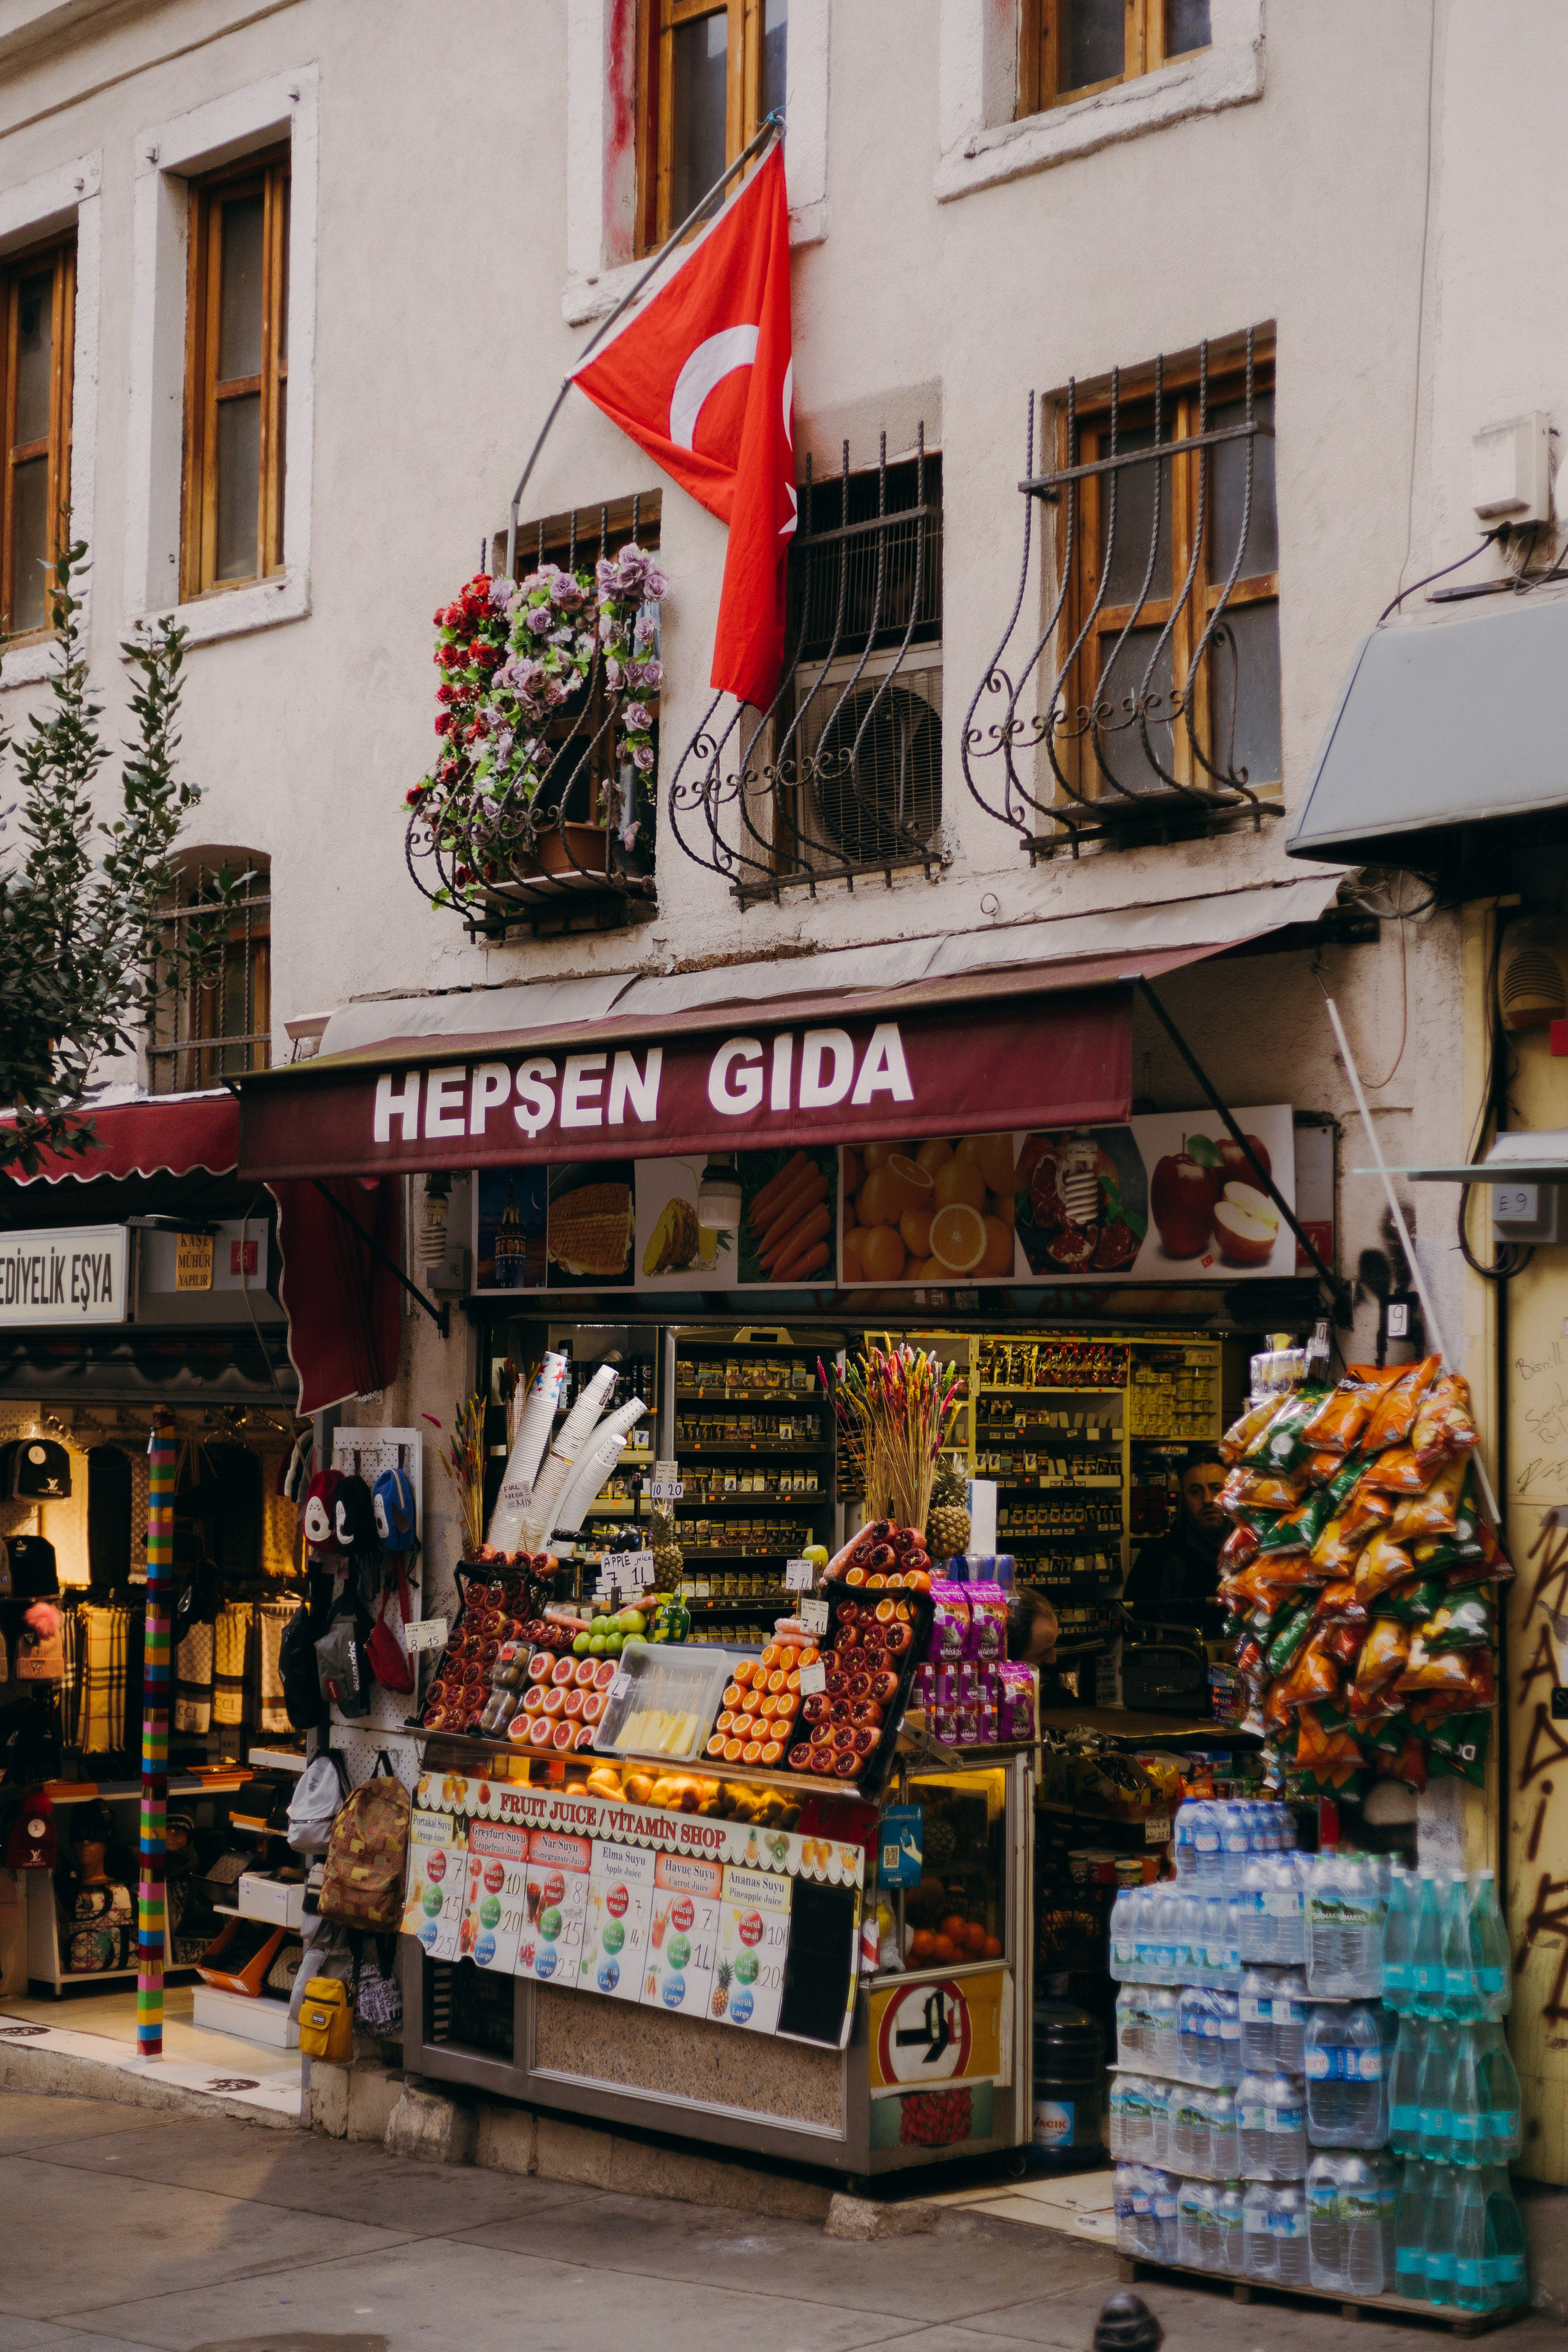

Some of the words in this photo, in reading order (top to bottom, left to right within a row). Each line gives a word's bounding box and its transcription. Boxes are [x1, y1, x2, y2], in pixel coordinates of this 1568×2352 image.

[374, 1047, 663, 1142] HEPŞEN
[707, 1023, 914, 1115] GIDA
[178, 1250, 210, 1268] MÜHÜR
[71, 1254, 112, 1311] EŞYA
[179, 1274, 208, 1286] YAPILIR
[654, 1485, 661, 1496] 10
[668, 1484, 682, 1495] 20
[604, 1555, 630, 1568] APPLE
[606, 1572, 617, 1586] 7
[788, 1578, 794, 1589] 7
[799, 1577, 810, 1589] 14
[802, 1618, 809, 1631] 7
[815, 1621, 825, 1634] 14
[410, 1640, 418, 1651] 8
[427, 1636, 439, 1647] 15
[413, 1814, 436, 1829] Portakal
[437, 1819, 451, 1832] Suyu
[500, 1792, 546, 1818] FRUIT
[549, 1801, 597, 1826] JUICE
[608, 1807, 676, 1841] VİTAMİN
[680, 1823, 726, 1850] SHOP
[472, 1824, 505, 1840] Greyfurt
[506, 1830, 526, 1845] Suyu
[473, 1839, 505, 1855] Grapefruit
[506, 1845, 522, 1856] Juice
[541, 1835, 556, 1849] Nar
[557, 1838, 579, 1853] Suyu
[1197, 1838, 1218, 1847] abant
[429, 1856, 445, 1866] Küçük
[532, 1848, 568, 1865] Pomegranate
[568, 1855, 586, 1867] Juice
[602, 1846, 624, 1862] Elma
[625, 1852, 646, 1868] Suyu
[429, 1868, 444, 1877] Small
[452, 1858, 463, 1881] 7
[486, 1868, 503, 1878] Küçük
[604, 1863, 623, 1875] Apple
[624, 1866, 641, 1879] Juice
[665, 1858, 692, 1877] Havuç
[693, 1863, 715, 1880] Suyu
[486, 1879, 501, 1888] Small
[546, 1878, 564, 1889] Küçük
[668, 1875, 690, 1889] Carrot
[691, 1881, 709, 1893] Juice
[728, 1871, 761, 1888] Ananas
[762, 1875, 785, 1894] Suyu
[546, 1890, 562, 1899] Small
[573, 1881, 582, 1904] 8
[609, 1891, 627, 1902] Küçük
[729, 1887, 763, 1903] Pineapple
[763, 1894, 783, 1907] Juice
[443, 1896, 462, 1921] 15
[635, 1900, 642, 1915] 7
[674, 1904, 693, 1915] Küçük
[502, 1910, 521, 1932] 20
[545, 1916, 558, 1924] Orta
[674, 1915, 691, 1926] Small
[703, 1909, 712, 1929] 7
[742, 1918, 761, 1929] Küçük
[562, 1921, 582, 1946] 15
[630, 1928, 639, 1948] 14
[742, 1930, 759, 1940] Small
[767, 1926, 783, 1945] 10
[477, 1940, 494, 1950] Büyük
[605, 1937, 622, 1947] Medium
[476, 1950, 492, 1961] Large
[538, 1951, 556, 1963] Büyük
[694, 1944, 710, 1971] 14
[537, 1963, 553, 1973] Large
[665, 1980, 684, 1992] Büyük
[665, 1992, 681, 2003] Large
[733, 1995, 752, 2007] Büyük
[732, 2008, 749, 2019] Large
